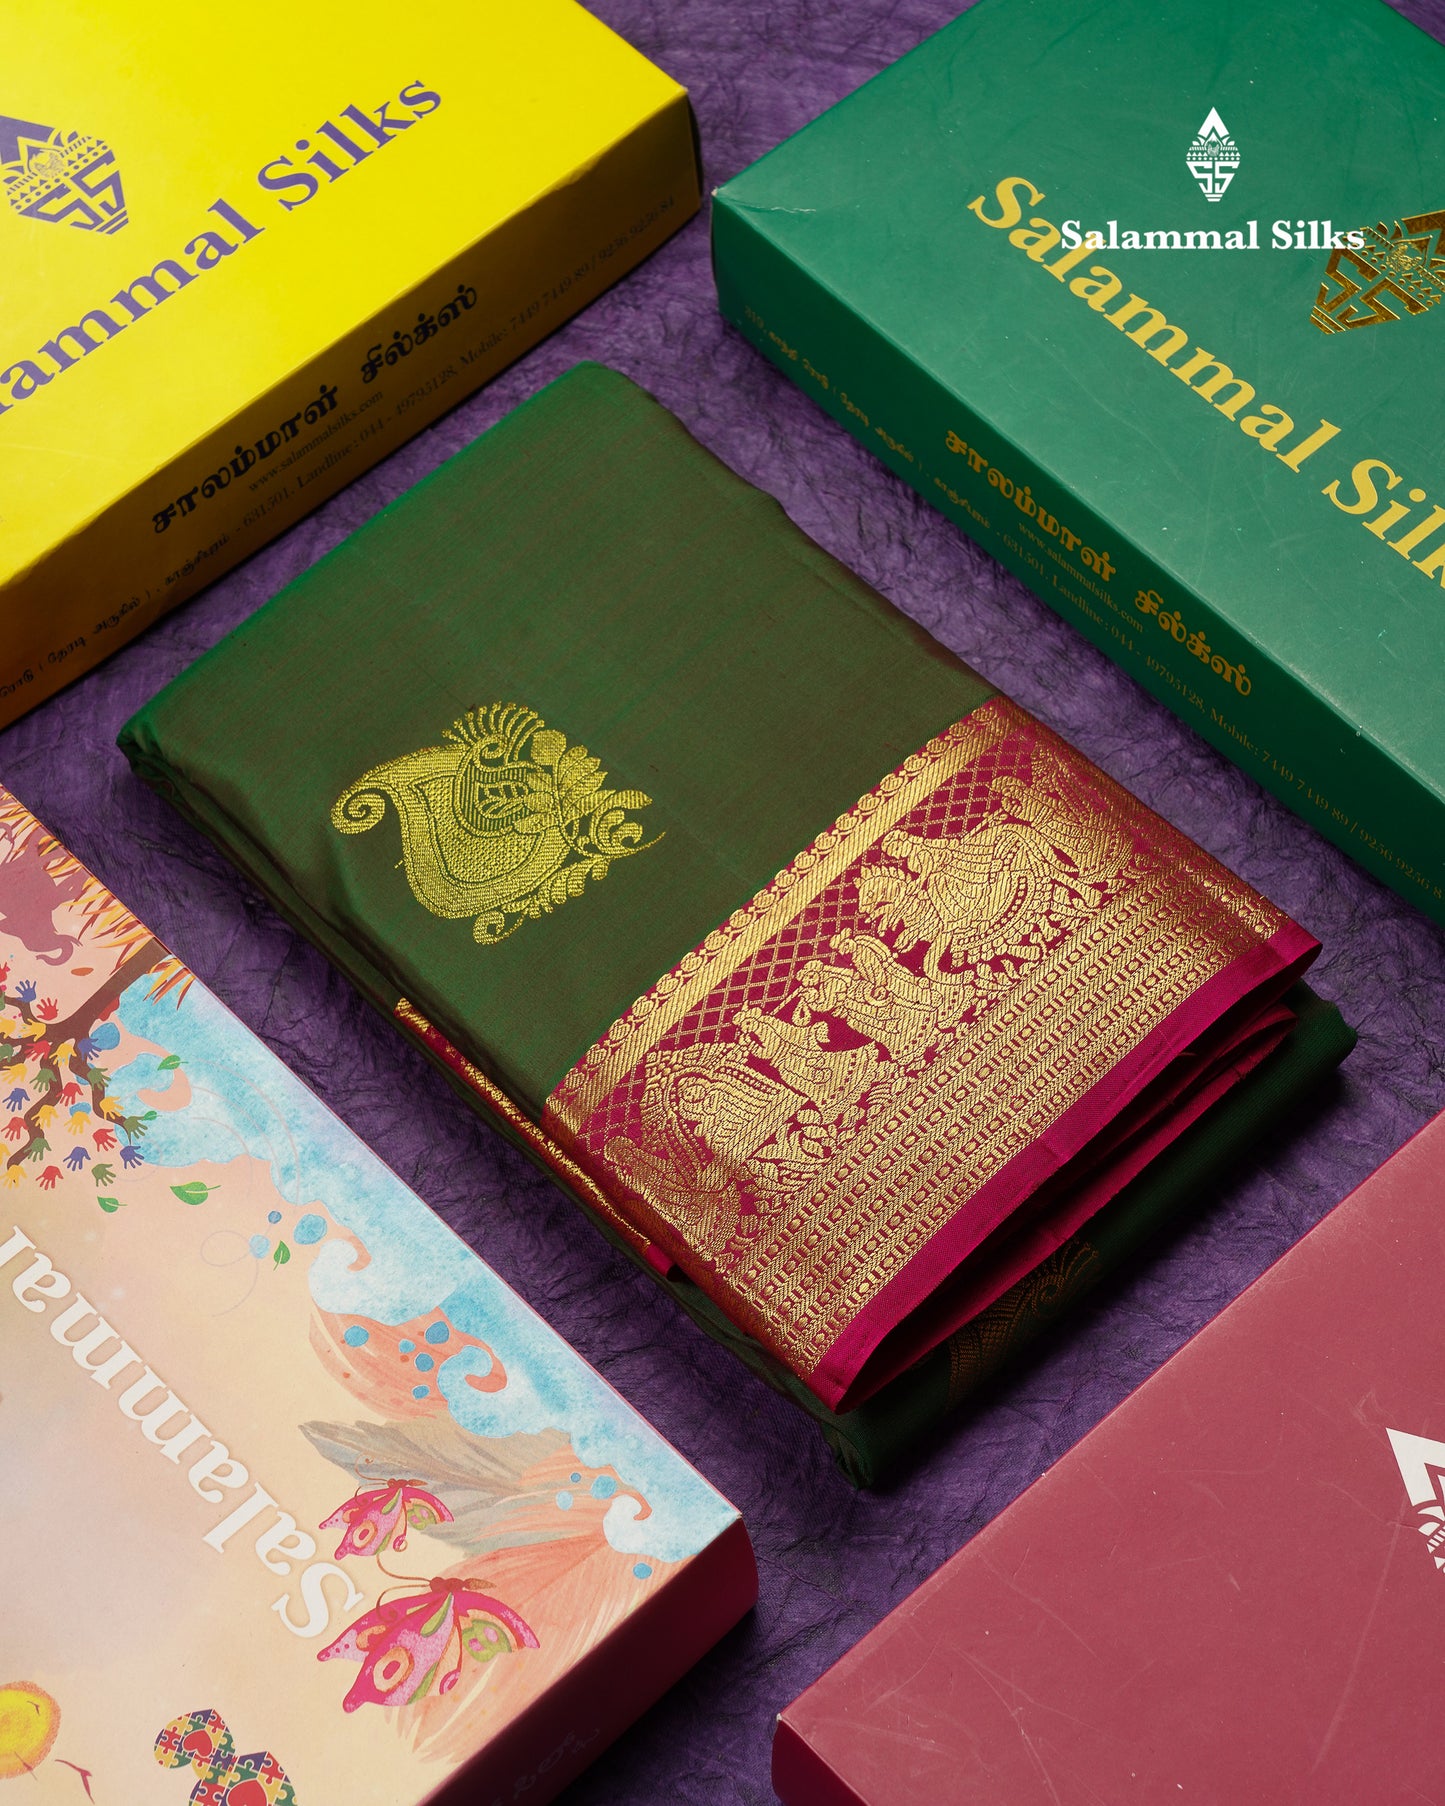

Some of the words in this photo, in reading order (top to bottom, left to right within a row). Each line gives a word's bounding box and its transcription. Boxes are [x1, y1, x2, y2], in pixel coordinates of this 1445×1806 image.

[257, 80, 442, 211] Silks
[151, 384, 340, 534] சாலம்மாள்
[360, 284, 479, 385] சில்க்ஸ்
[968, 177, 1340, 473] Salammal
[247, 391, 384, 492] www.salammalsilks.com
[945, 430, 1118, 582] சாலம்மாள்
[1134, 589, 1252, 696] சில்க்ஸ்
[1017, 523, 1145, 634] www.salammalsilks.com
